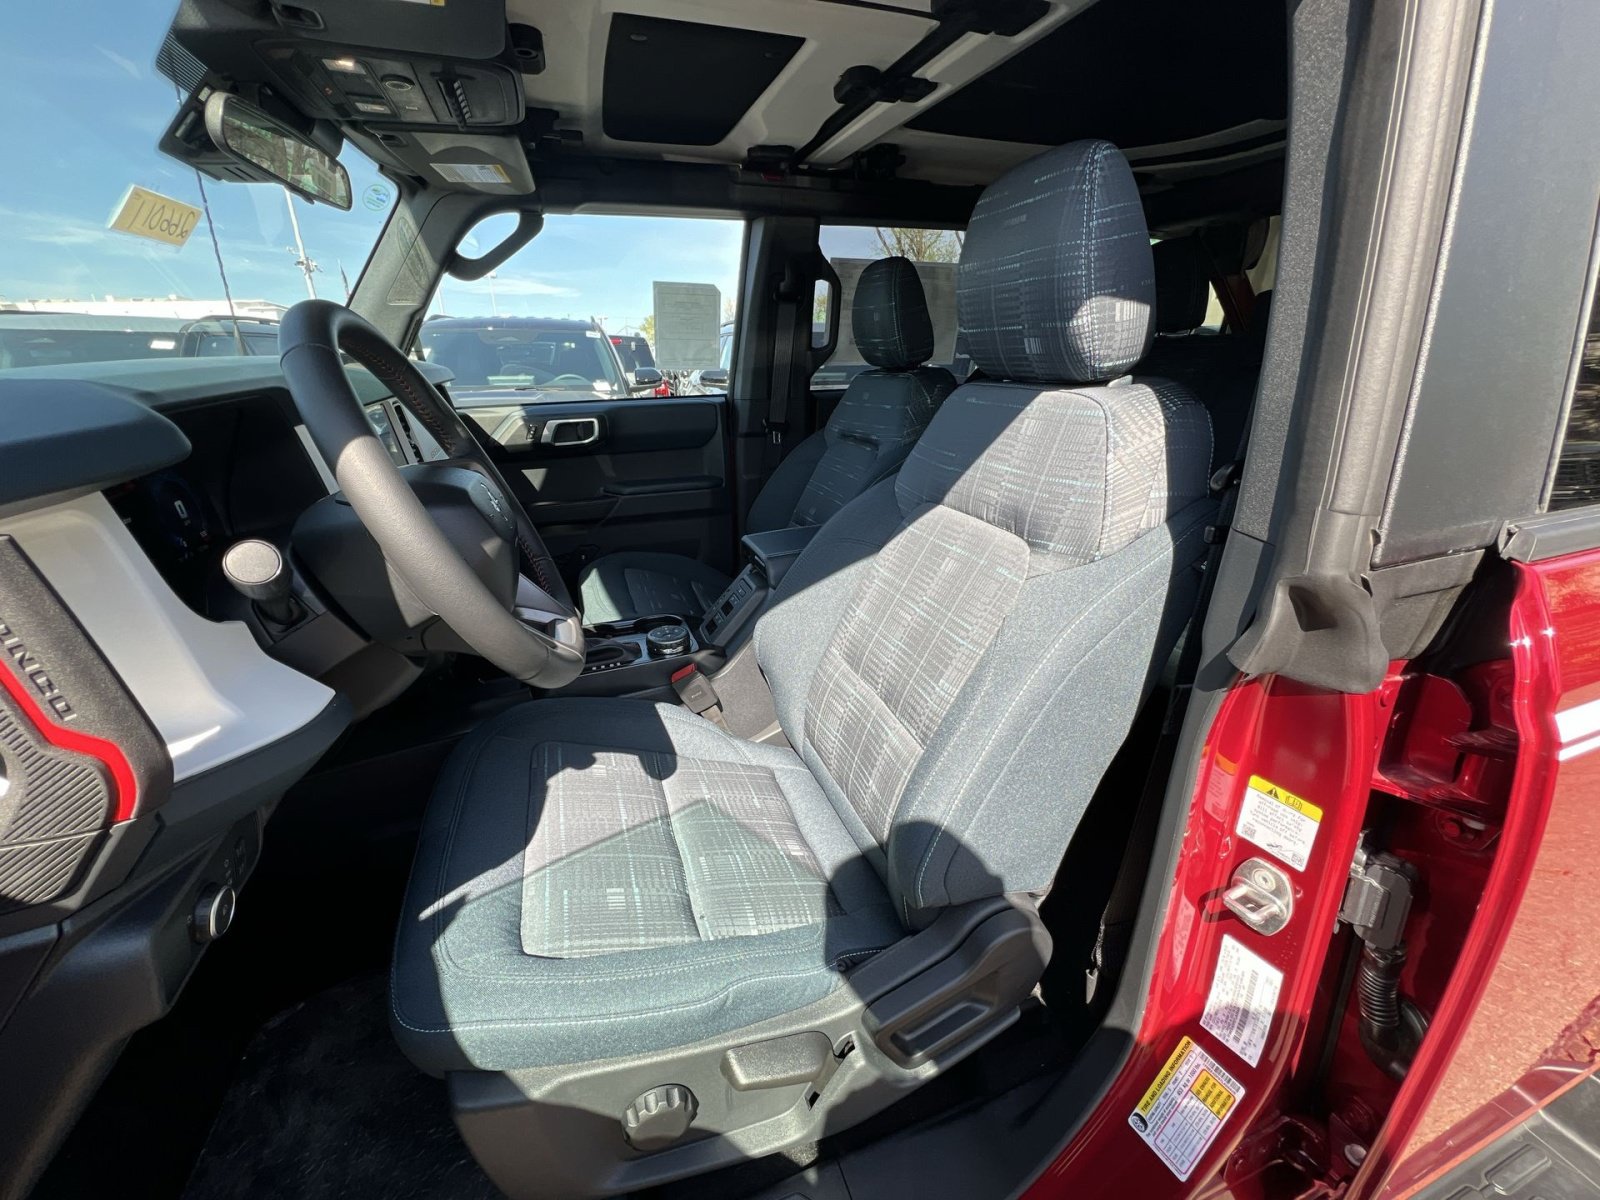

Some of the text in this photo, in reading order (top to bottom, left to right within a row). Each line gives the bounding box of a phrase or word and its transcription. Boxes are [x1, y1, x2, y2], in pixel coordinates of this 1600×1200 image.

[1140, 1039, 1191, 1112] TIRE AND LOADING INFORMATION
